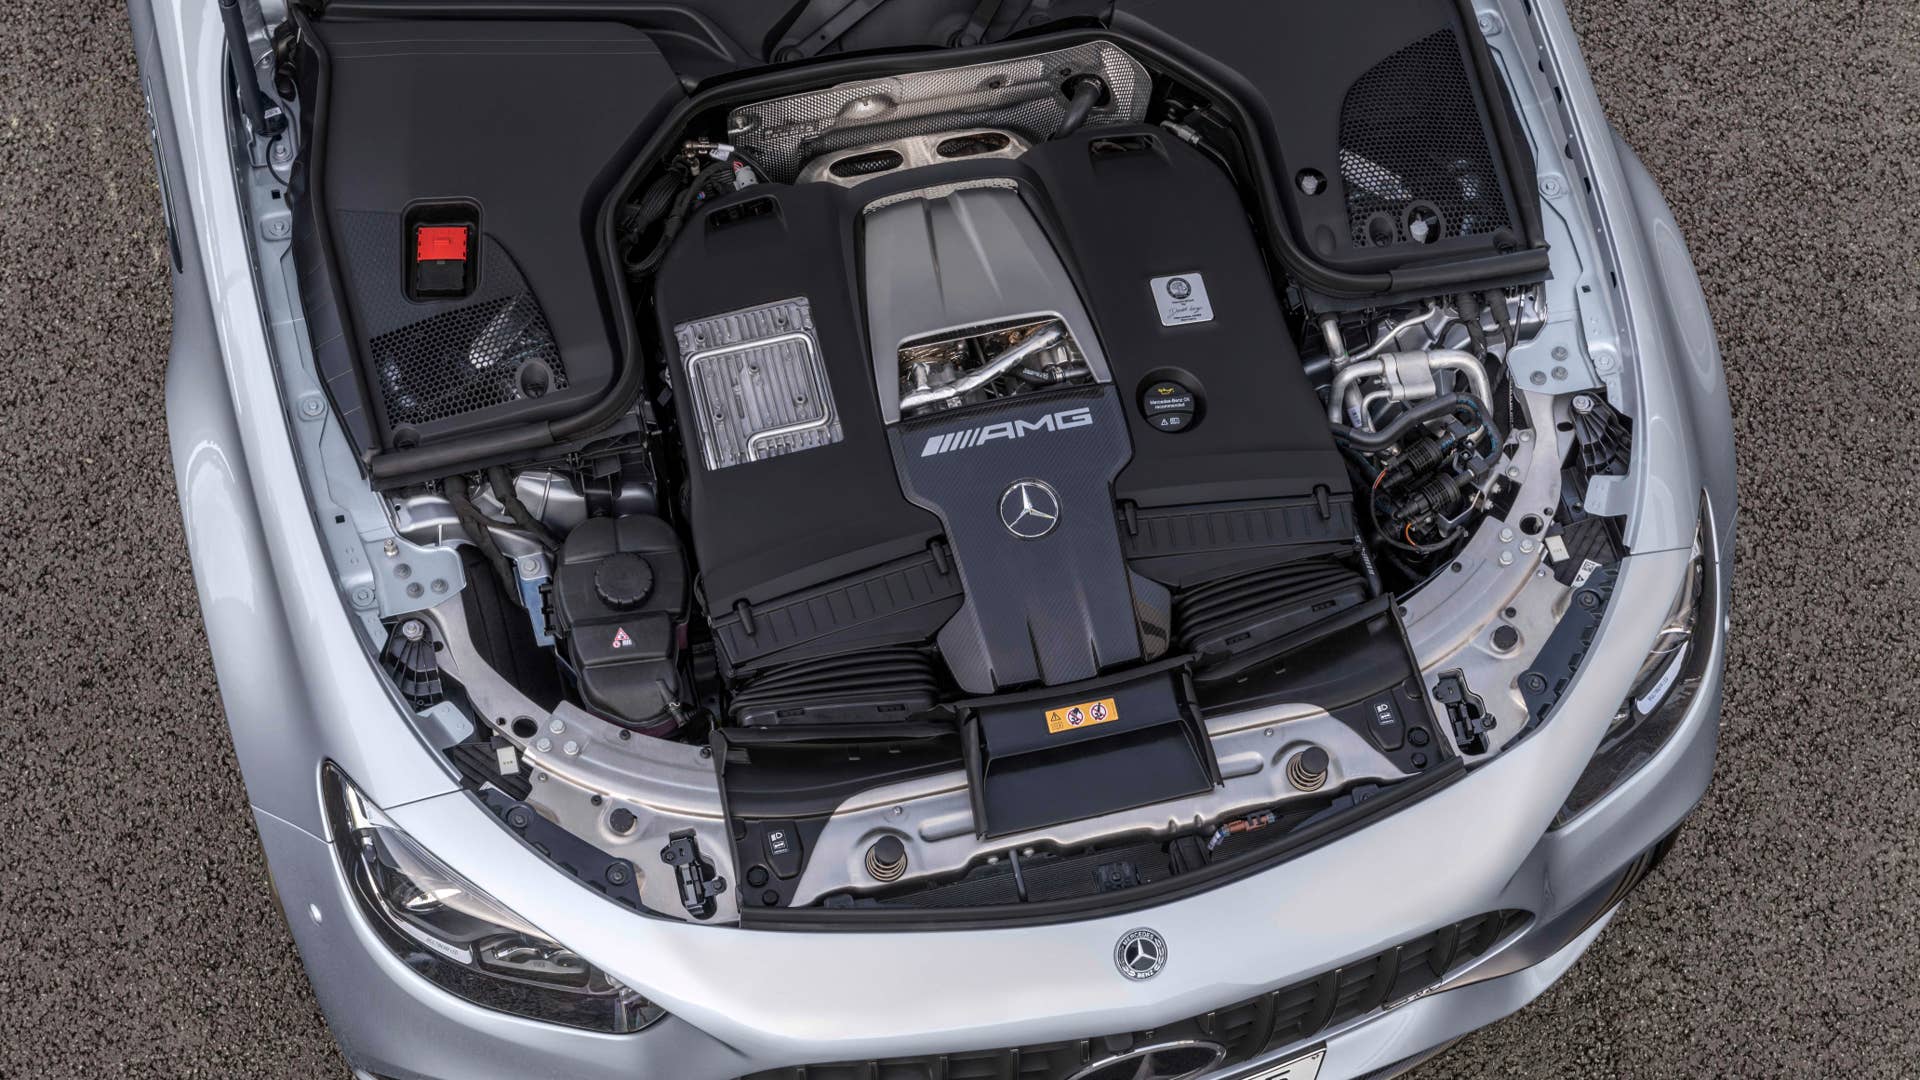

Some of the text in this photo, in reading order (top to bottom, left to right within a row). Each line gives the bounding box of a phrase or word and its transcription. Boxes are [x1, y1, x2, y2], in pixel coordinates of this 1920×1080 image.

[976, 407, 1093, 446] AMG
[1122, 931, 1154, 945] MERCEDES
[1137, 970, 1154, 978] BENZ
